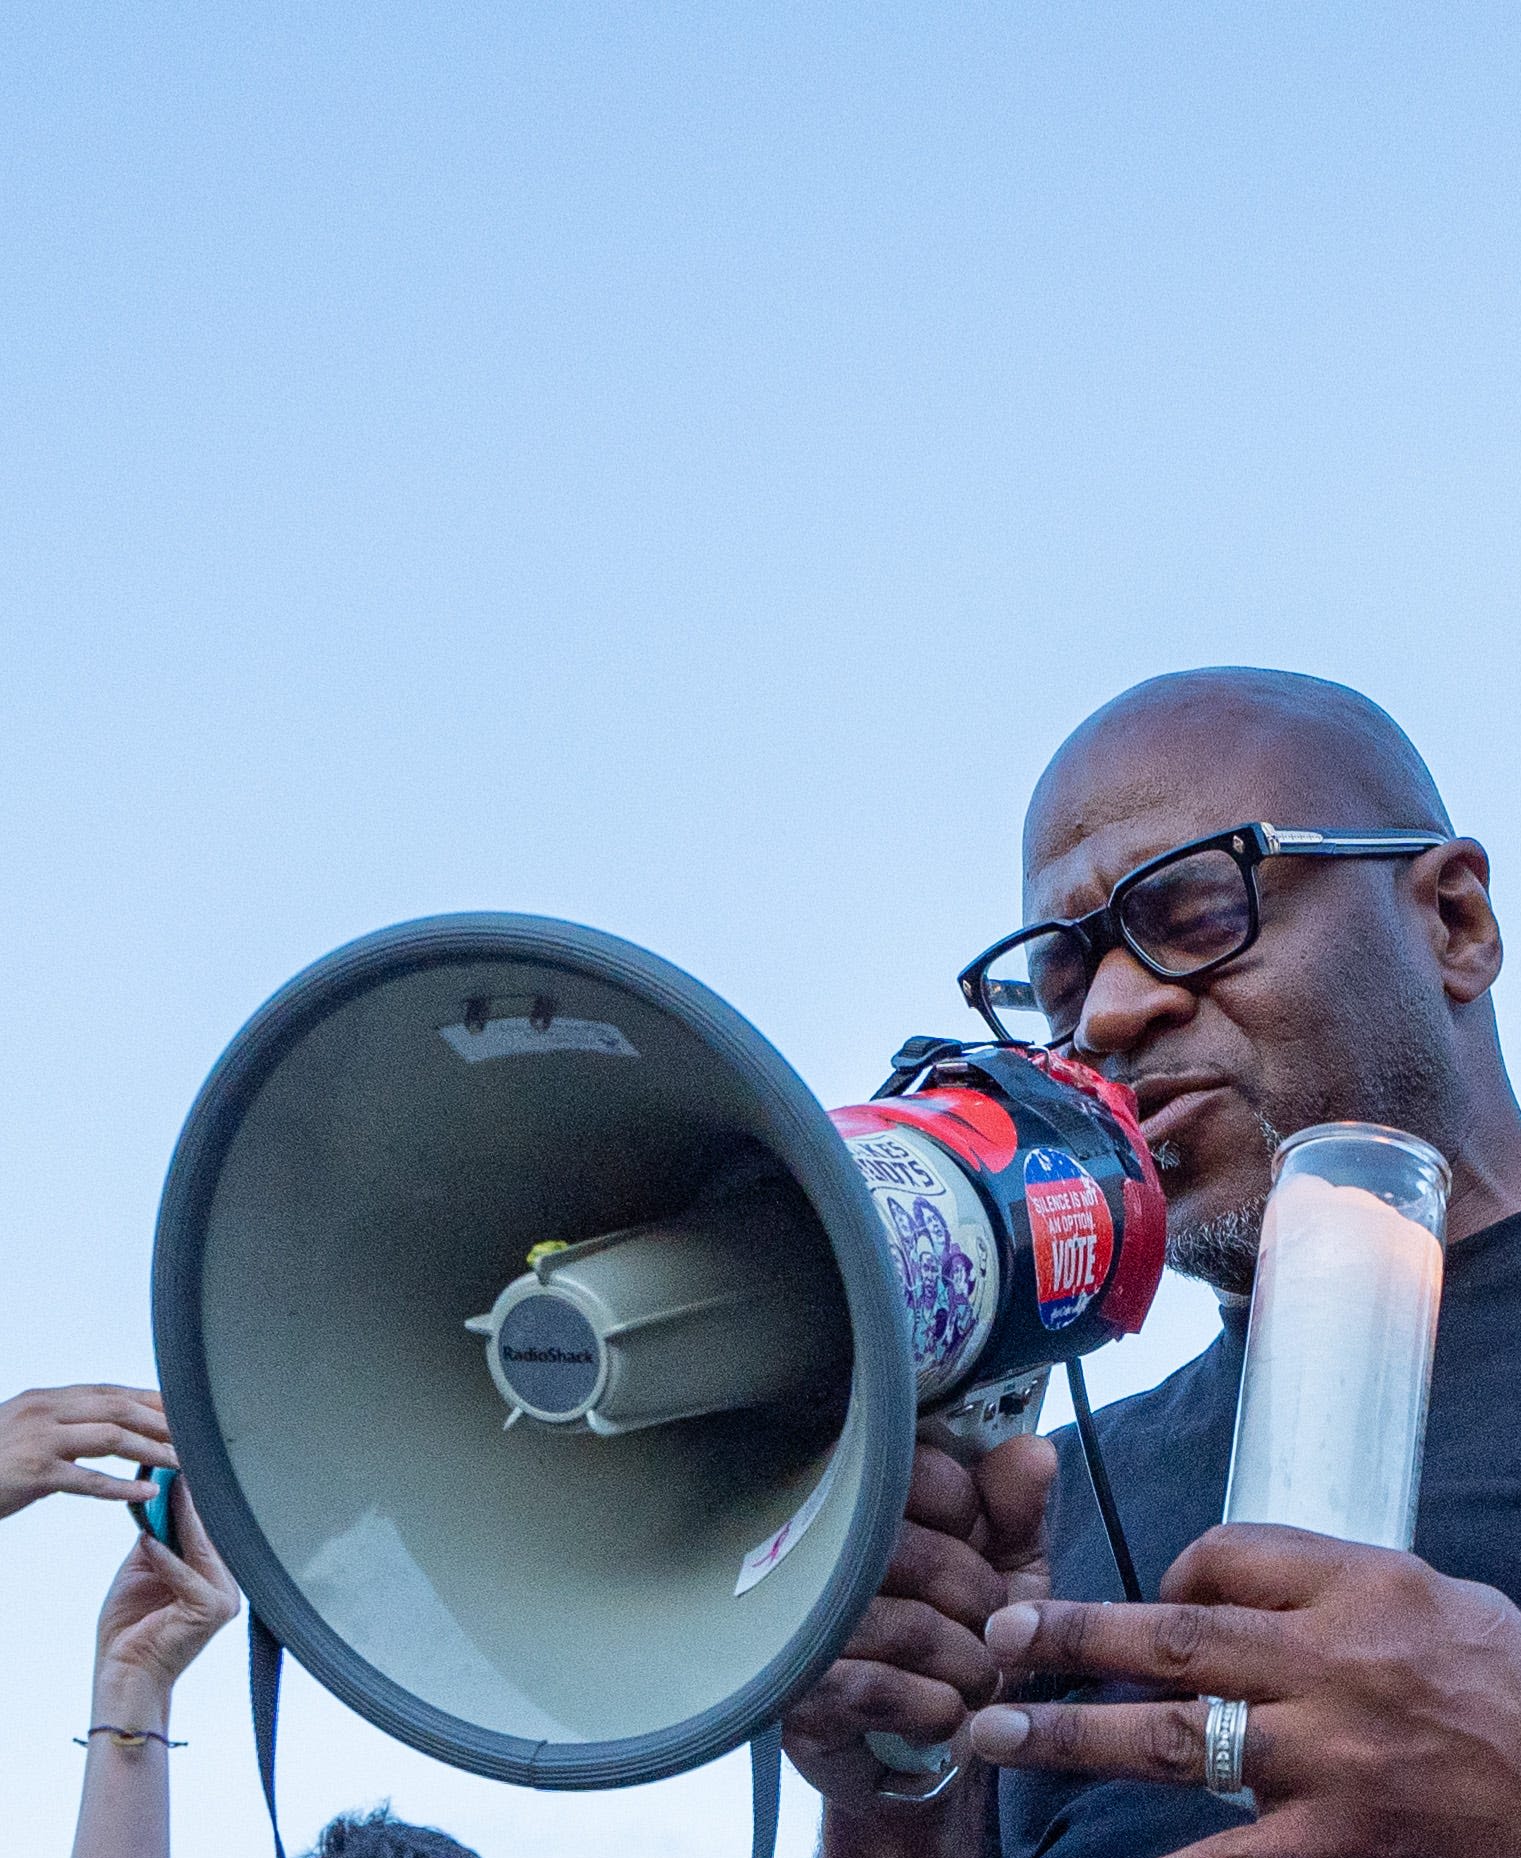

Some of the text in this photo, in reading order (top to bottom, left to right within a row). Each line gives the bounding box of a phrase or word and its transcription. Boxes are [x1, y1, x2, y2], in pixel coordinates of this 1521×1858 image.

[1033, 1187, 1098, 1214] SILENCE IS NOT
[1048, 1215, 1061, 1233] AN
[1051, 1234, 1097, 1292] VOTE
[503, 1345, 593, 1364] RadioShack
